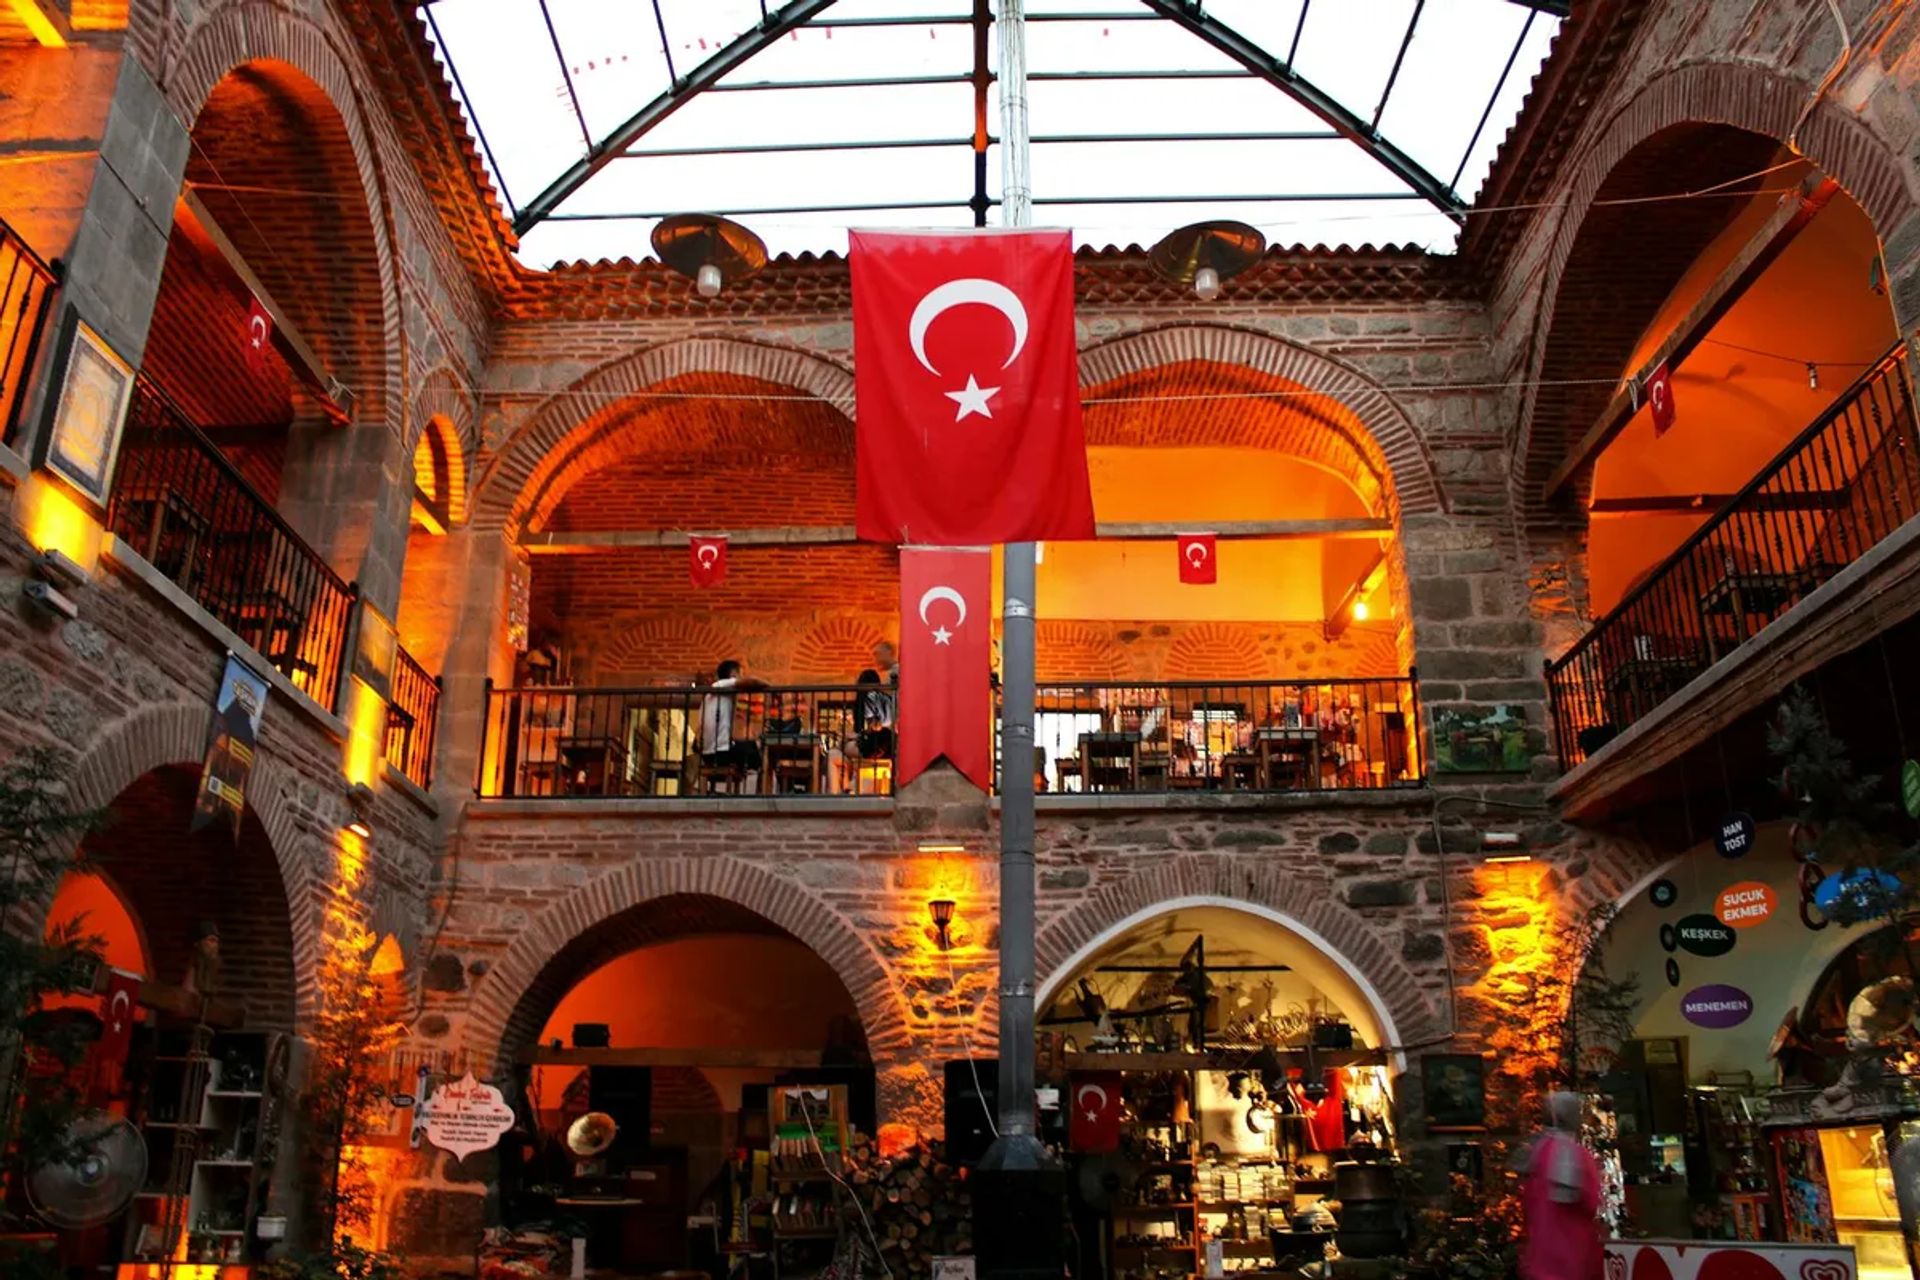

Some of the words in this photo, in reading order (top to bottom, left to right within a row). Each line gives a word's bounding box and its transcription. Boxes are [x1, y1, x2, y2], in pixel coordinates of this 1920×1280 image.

[1723, 821, 1743, 837] HAN
[1724, 834, 1746, 852] TOST
[1723, 888, 1765, 906] SUCUK
[1723, 904, 1768, 921] EKMEK
[1681, 928, 1728, 941] KEŞKEK
[1685, 1001, 1748, 1013] MENEMEN
